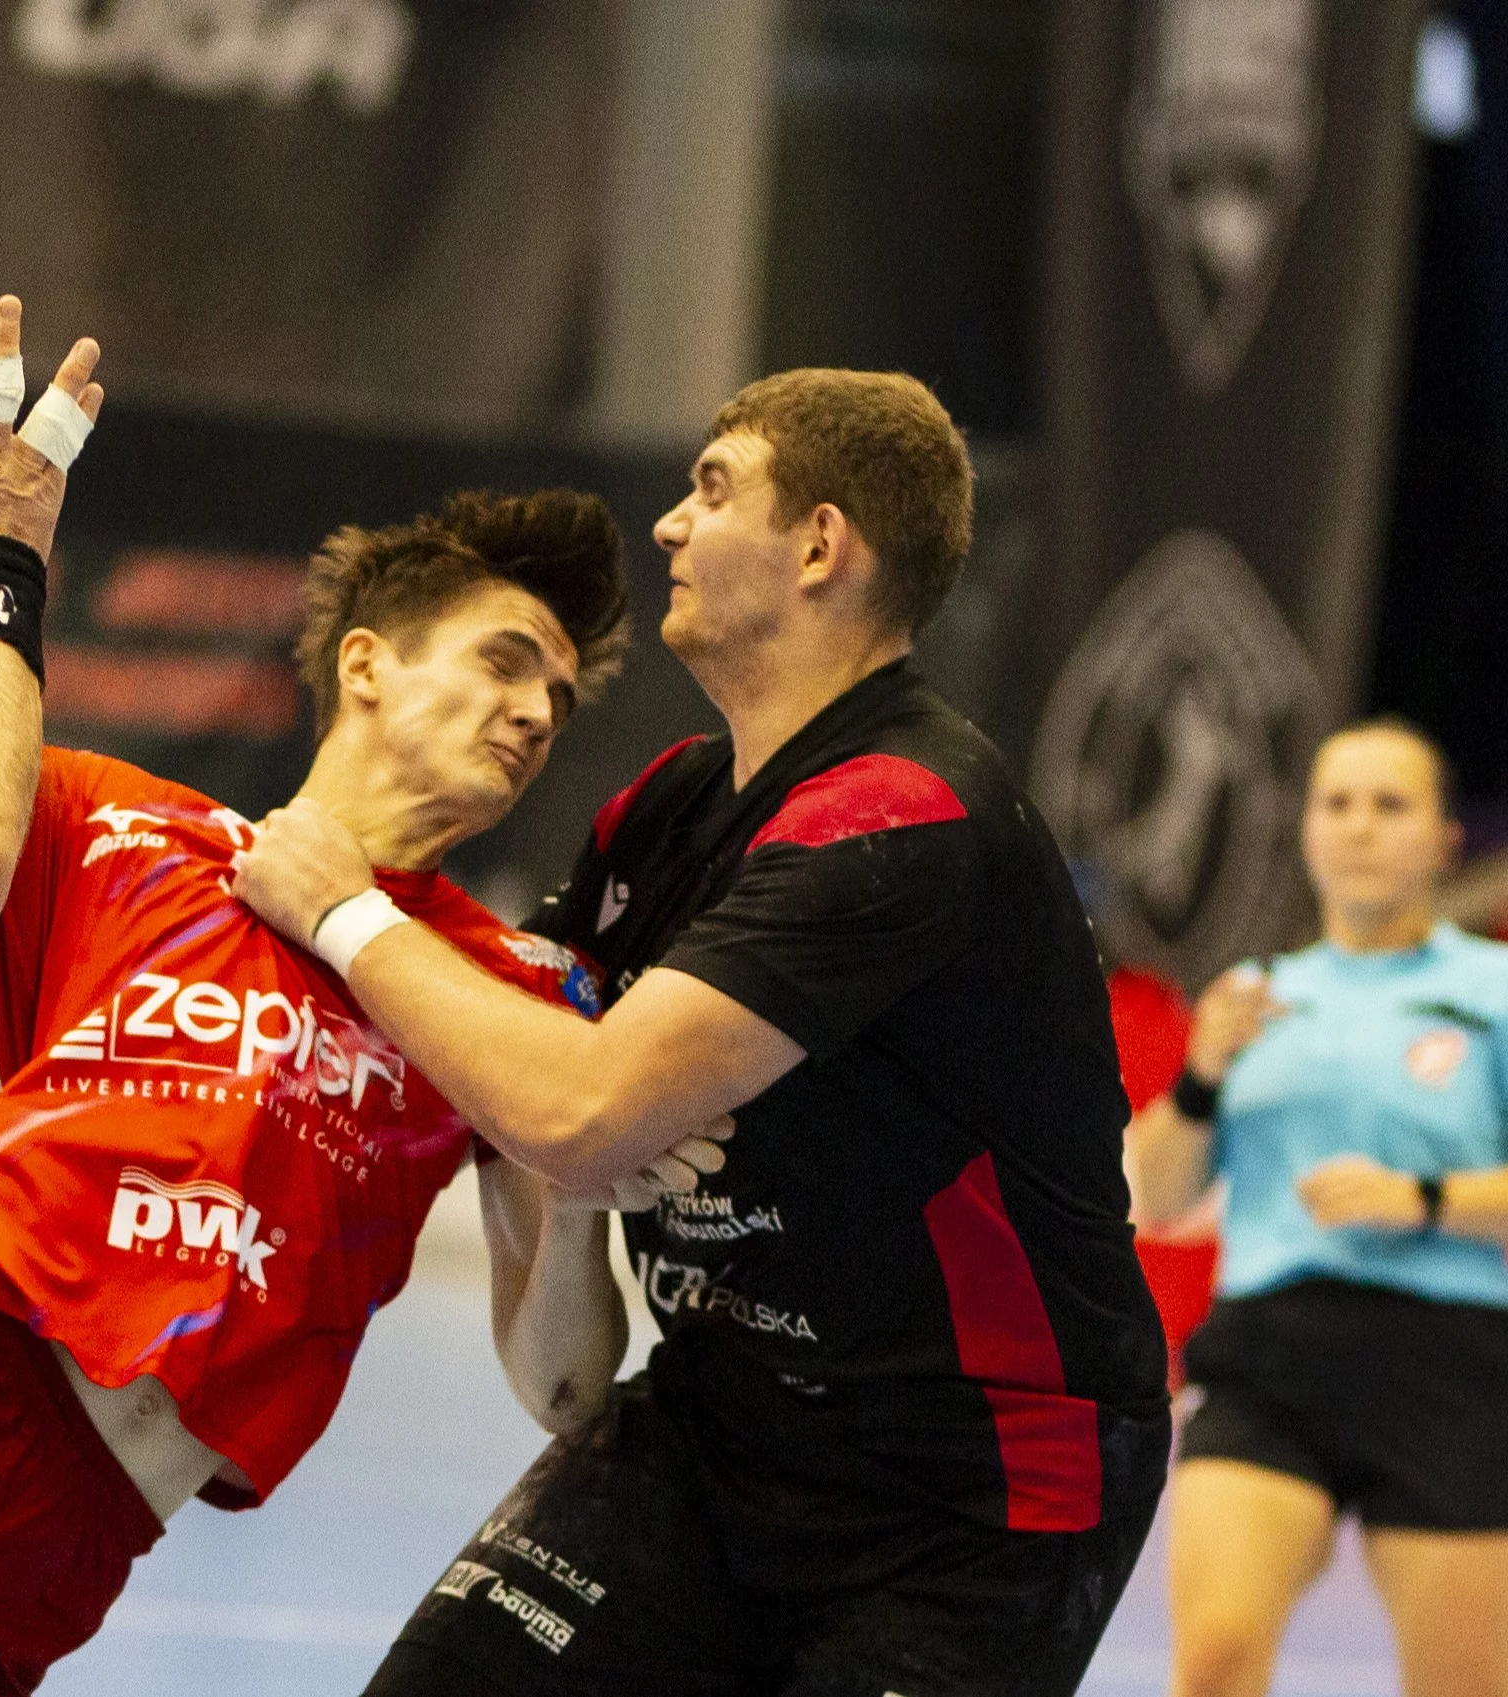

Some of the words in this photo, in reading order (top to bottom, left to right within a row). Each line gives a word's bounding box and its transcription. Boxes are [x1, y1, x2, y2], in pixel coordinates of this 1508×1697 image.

[45, 1076, 110, 1096] LIVE
[123, 1079, 227, 1103] BETTER
[107, 1187, 278, 1291] pwk
[487, 1579, 572, 1648] bauma
